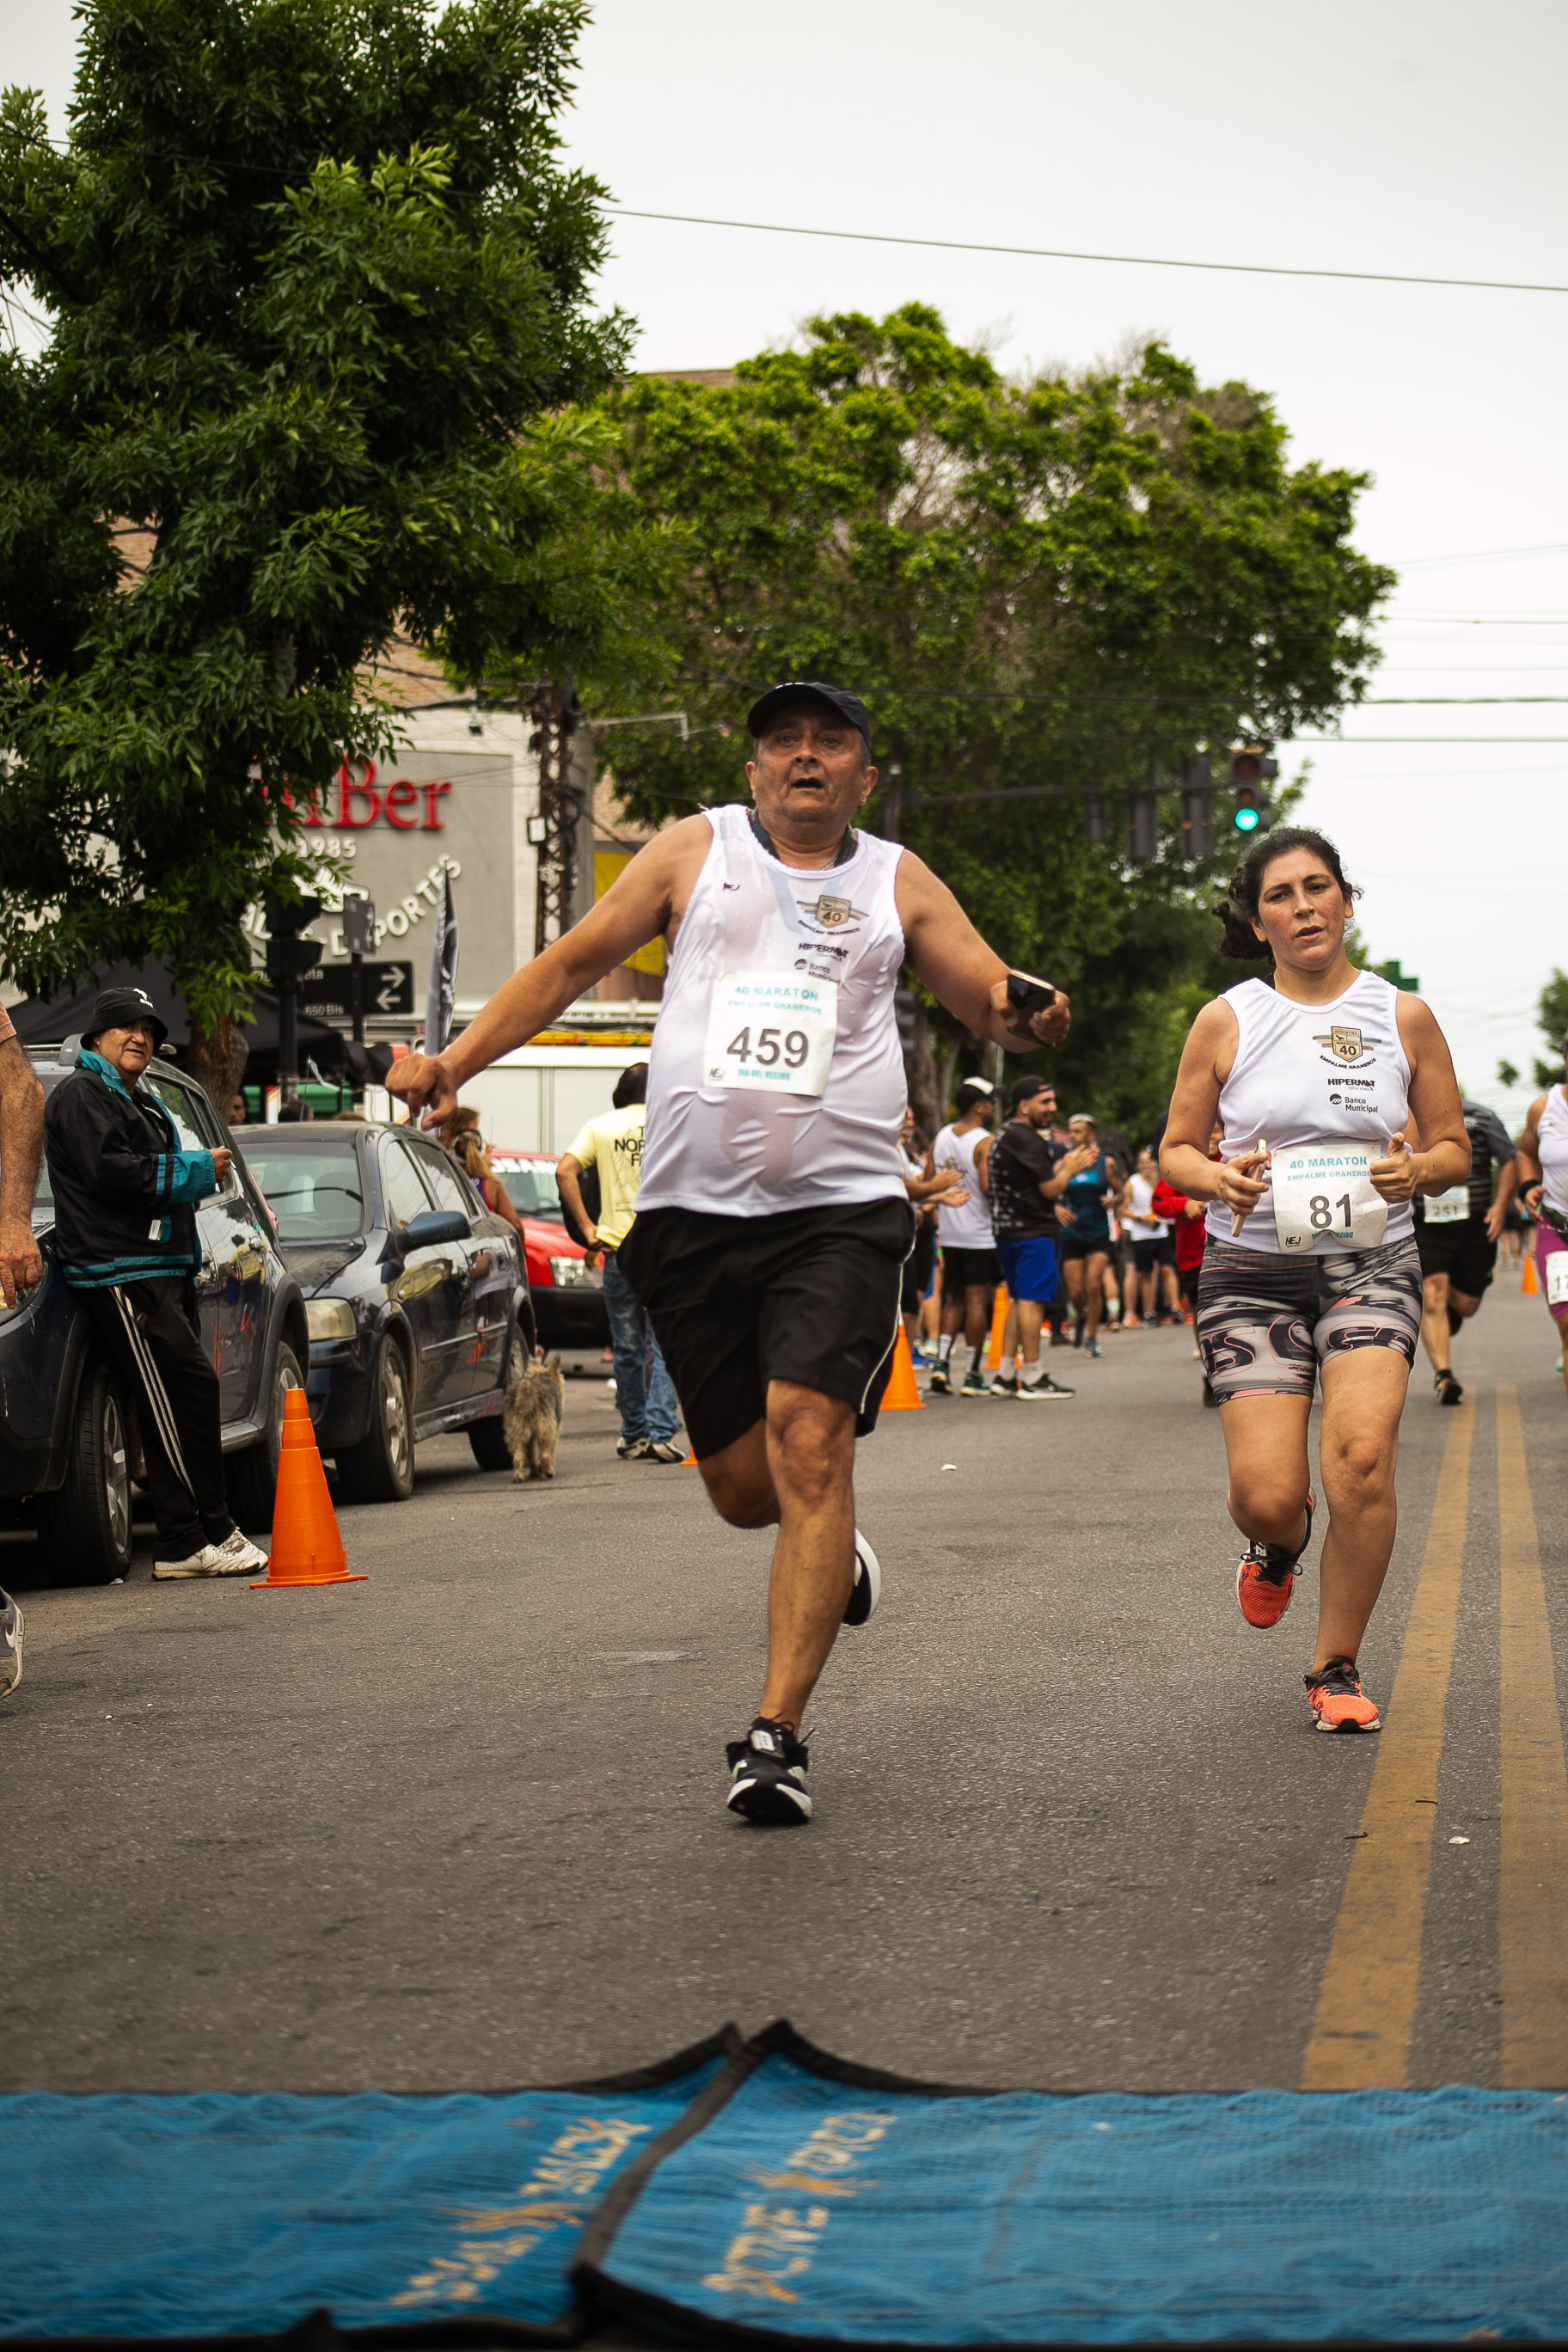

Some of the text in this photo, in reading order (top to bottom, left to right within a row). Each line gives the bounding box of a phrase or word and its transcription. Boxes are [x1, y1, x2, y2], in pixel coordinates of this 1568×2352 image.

[329, 853, 462, 956] DPORTES
[823, 912, 842, 922] 40
[734, 985, 819, 1001] 40 MARATON
[327, 1003, 344, 1015] Bis
[773, 1001, 823, 1015] GRANEROS
[726, 1026, 810, 1069] 459
[1339, 1045, 1357, 1056] 40
[1320, 1055, 1377, 1069] EMPALME GRANEROS
[709, 1068, 727, 1079] NEJ
[1344, 1096, 1366, 1105] Banco
[1345, 1104, 1379, 1114] Municipal
[1289, 1156, 1368, 1169] 40 MARATON
[1287, 1172, 1327, 1182] EMPALME
[1309, 1193, 1352, 1229] 81
[1285, 1236, 1302, 1246] NEJ
